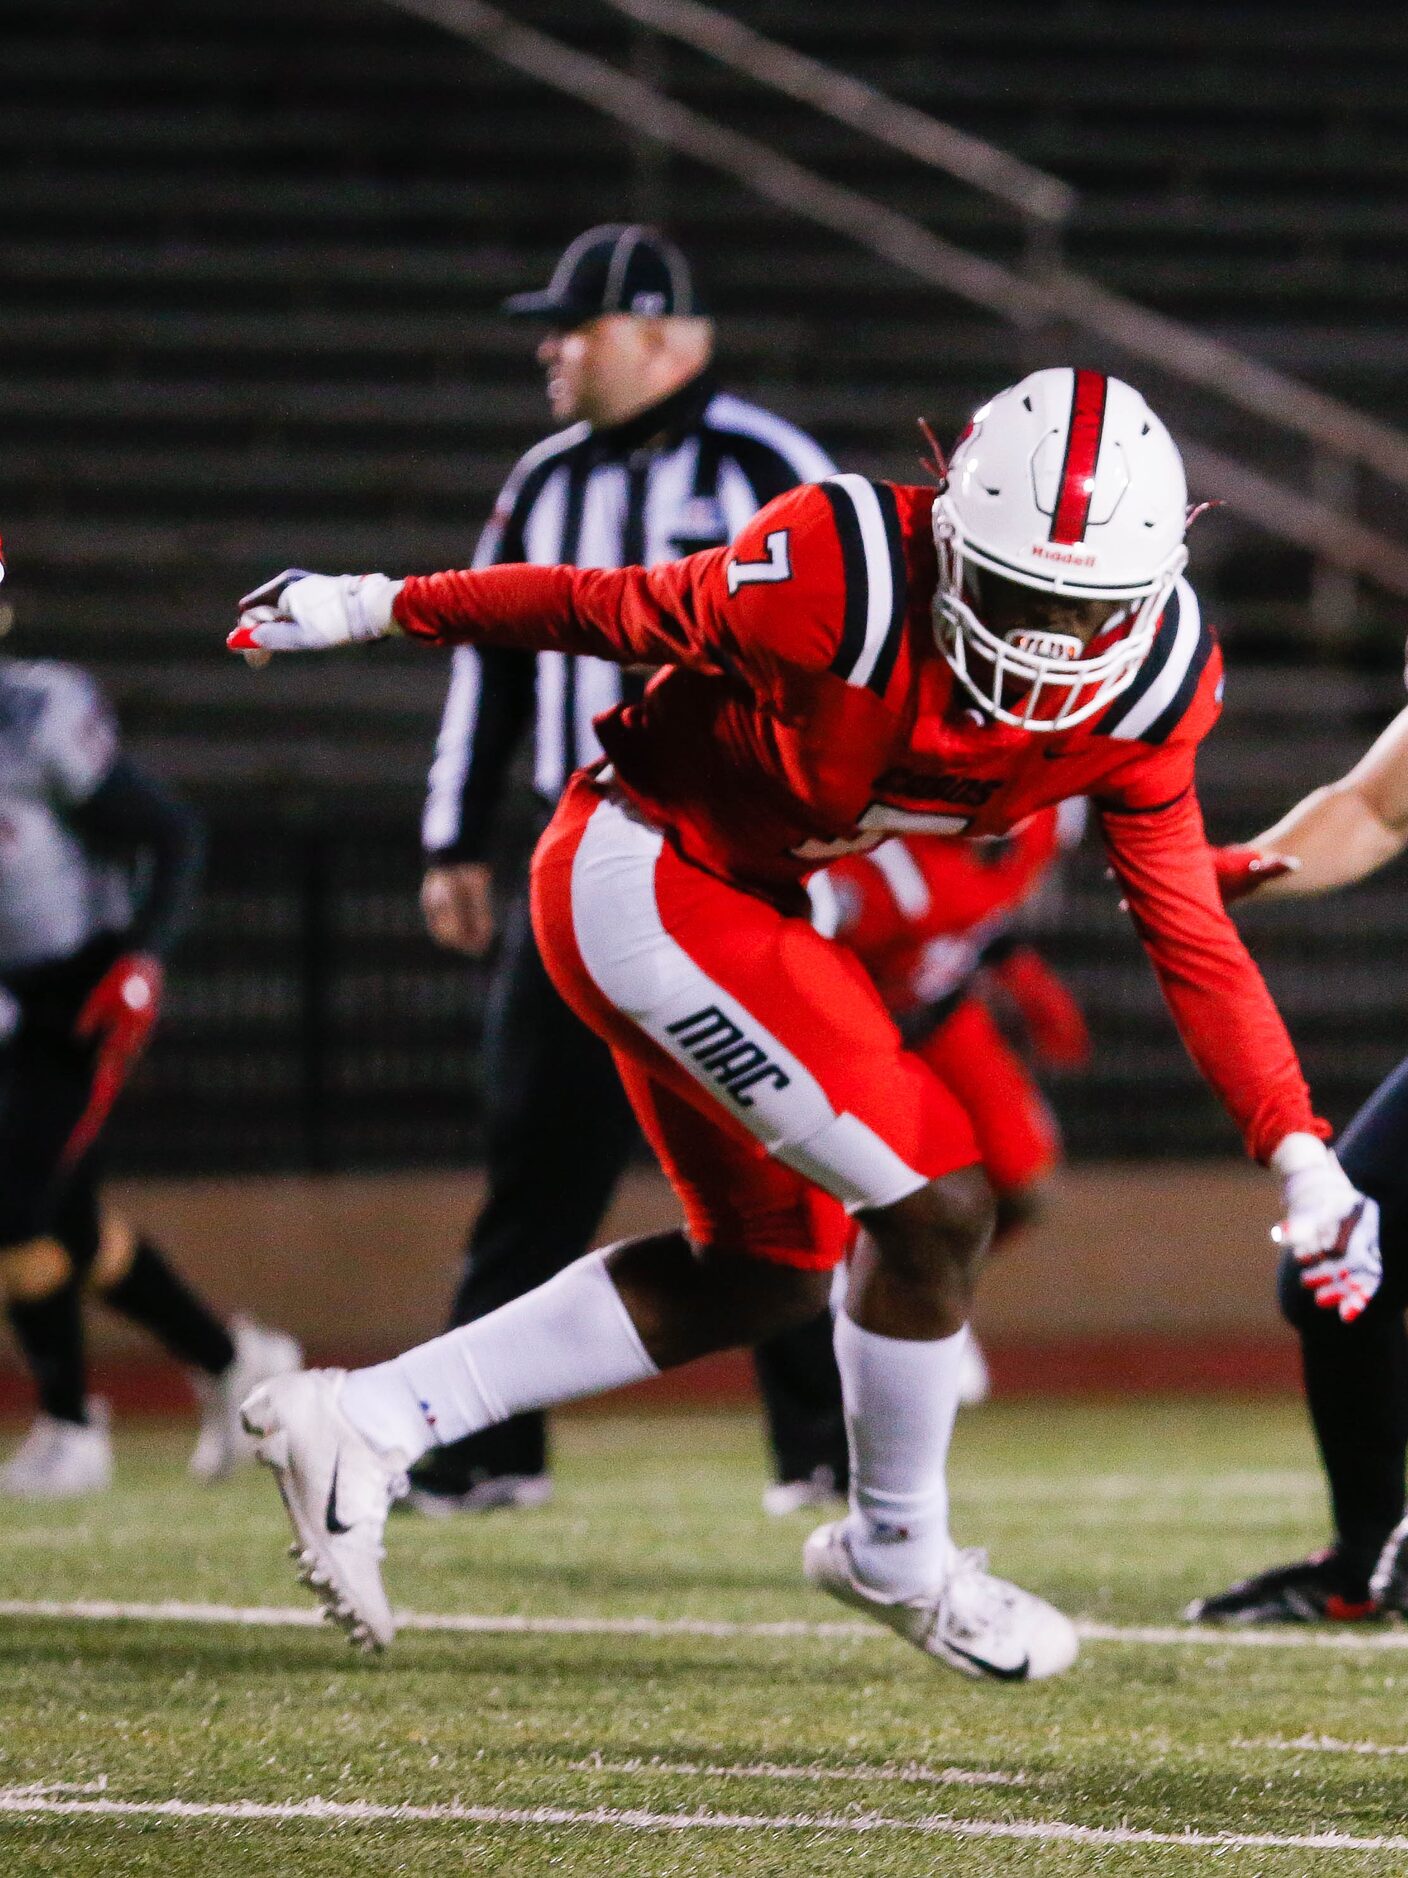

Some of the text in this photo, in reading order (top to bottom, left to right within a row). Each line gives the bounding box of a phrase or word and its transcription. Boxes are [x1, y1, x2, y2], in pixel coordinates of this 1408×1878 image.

[727, 527, 794, 599] 7
[1031, 545, 1096, 567] Riddell
[665, 1004, 791, 1107] MAC
